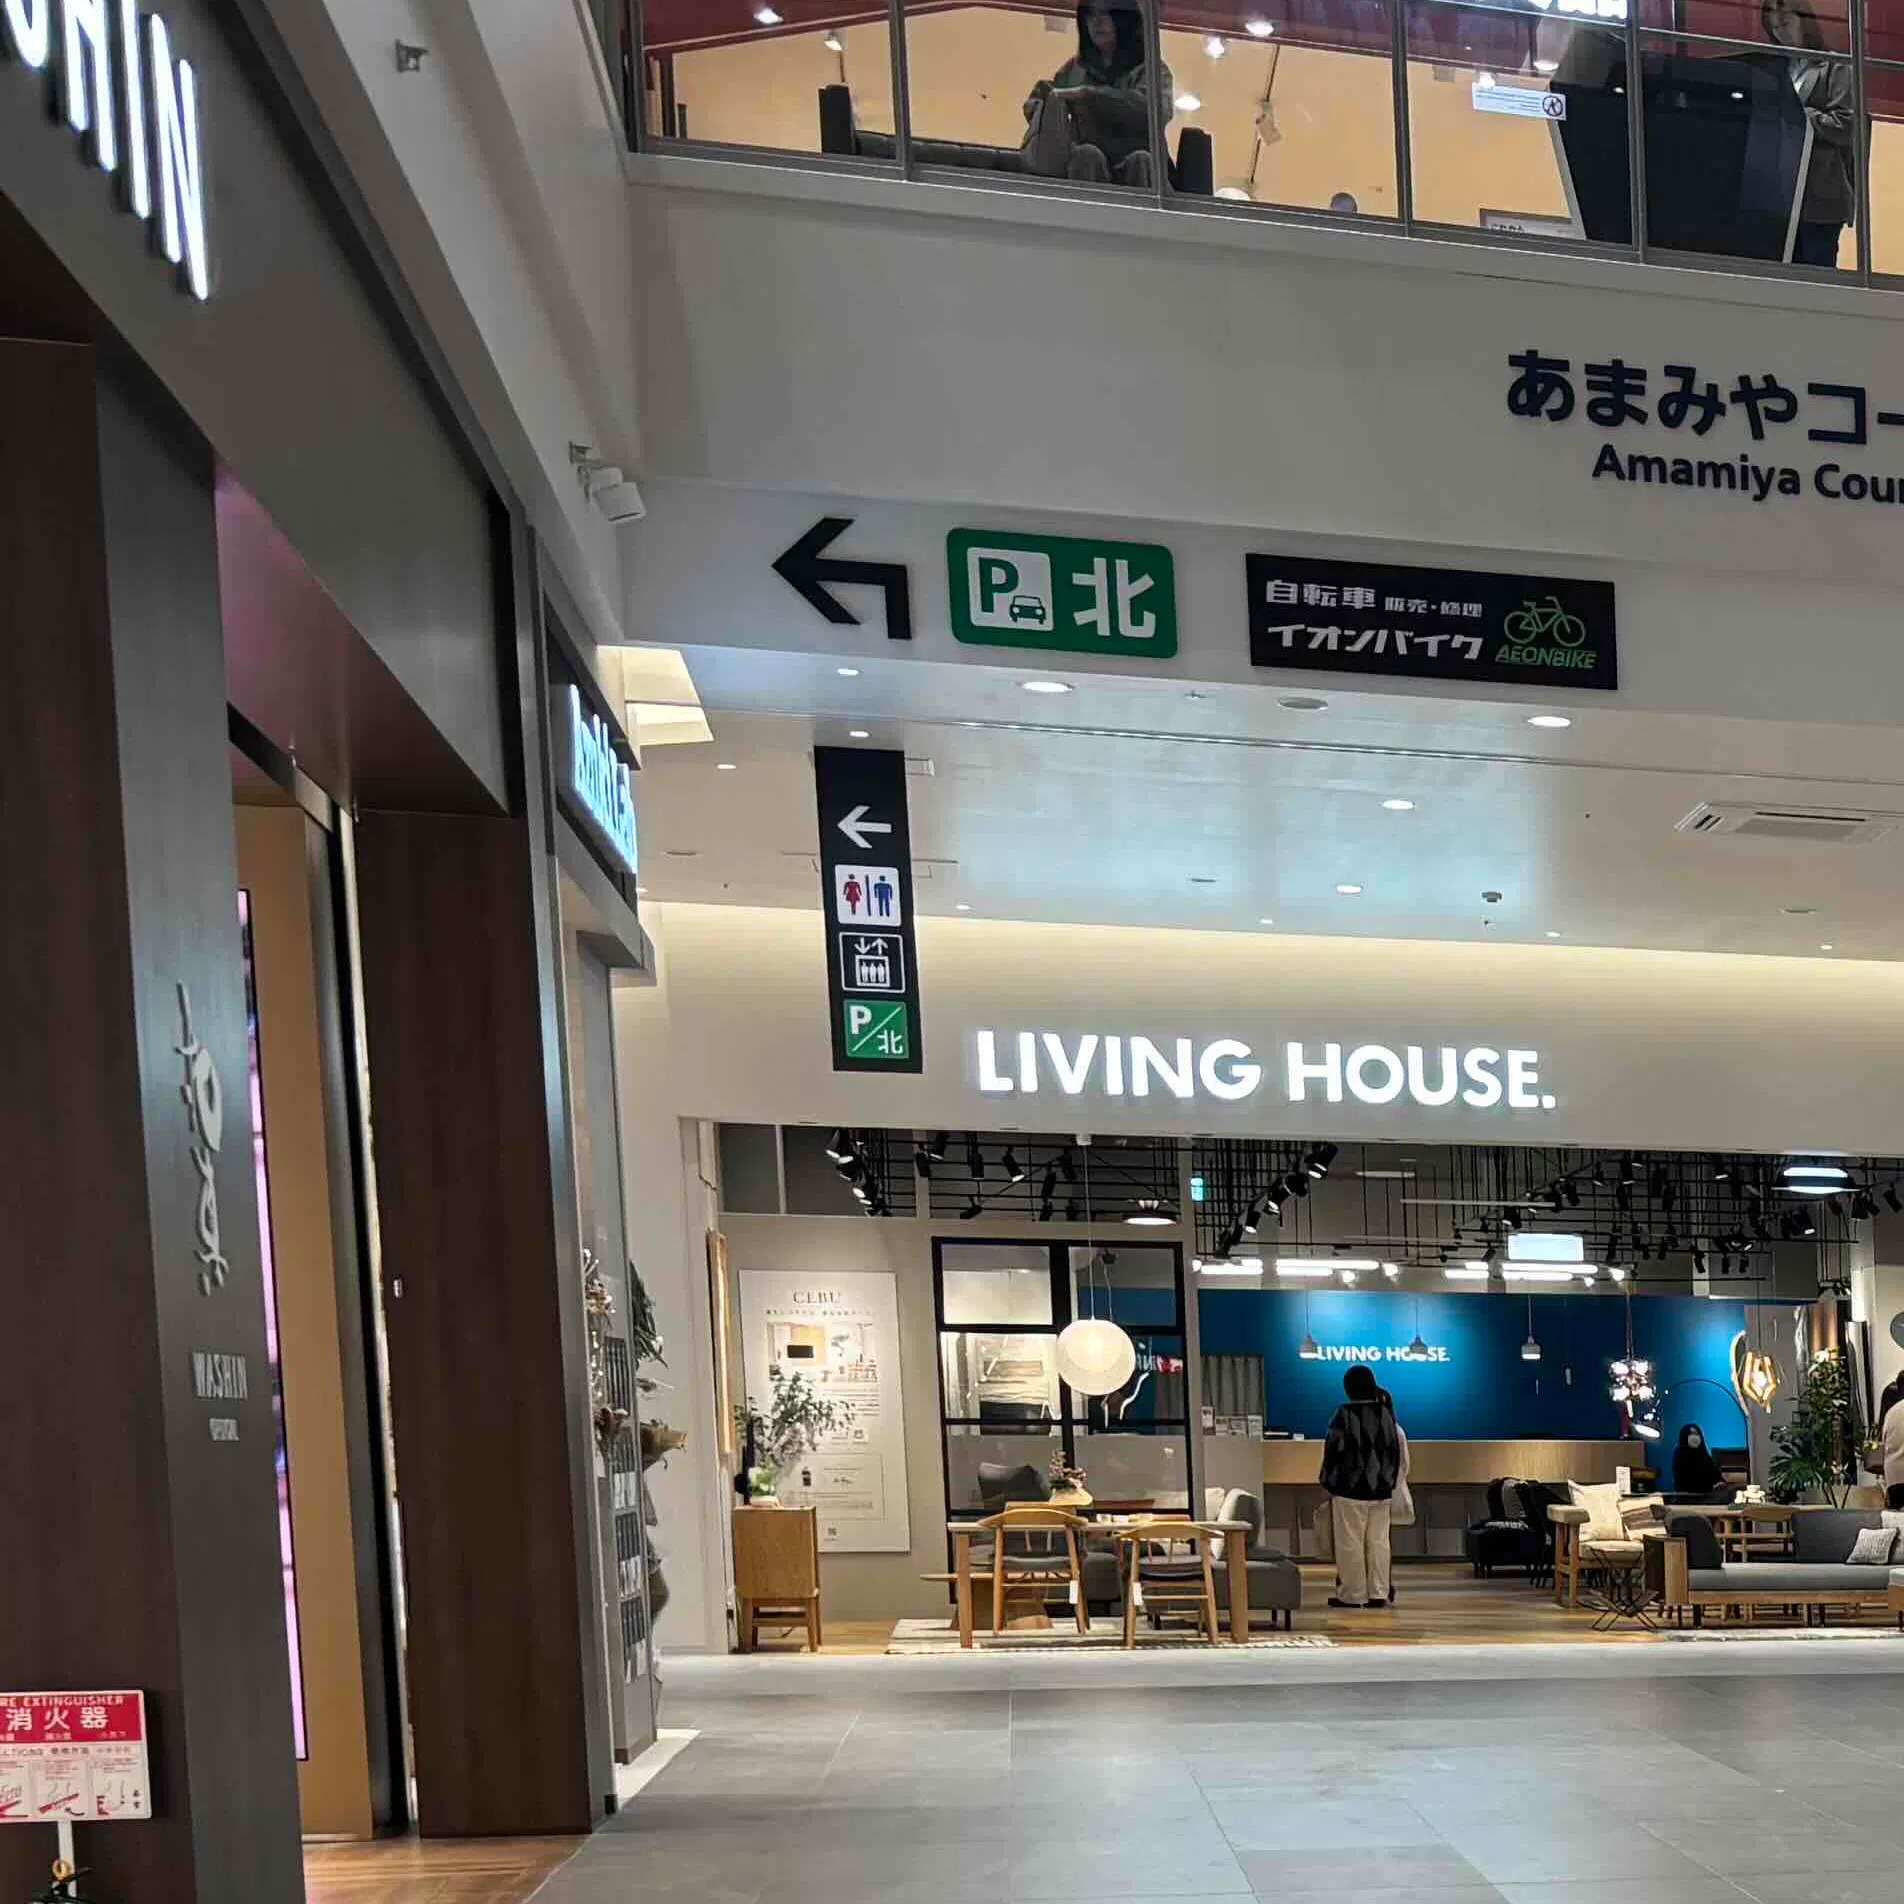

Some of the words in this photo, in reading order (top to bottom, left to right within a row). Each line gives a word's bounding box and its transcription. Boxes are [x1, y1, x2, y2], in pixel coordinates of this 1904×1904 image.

[2, 0, 208, 300] HIN
[1592, 443, 1800, 503] Amamiya
[979, 557, 1019, 614] P
[1072, 557, 1155, 638] 北
[1265, 579, 1376, 609] 自転車
[1267, 623, 1484, 660] イオンバイク
[1495, 643, 1598, 669] AEONBIKE
[850, 1004, 873, 1035] P
[876, 1029, 904, 1054] 北
[977, 1029, 1263, 1099] LIVING
[1286, 1040, 1557, 1109] HOUSE.
[1317, 1345, 1381, 1361] LIVING
[1386, 1346, 1450, 1361] HOSE.
[192, 1352, 248, 1400] WASHIN
[5, 1706, 109, 1731] 消火器
[23, 1695, 125, 1707] EXTINGUISHER
